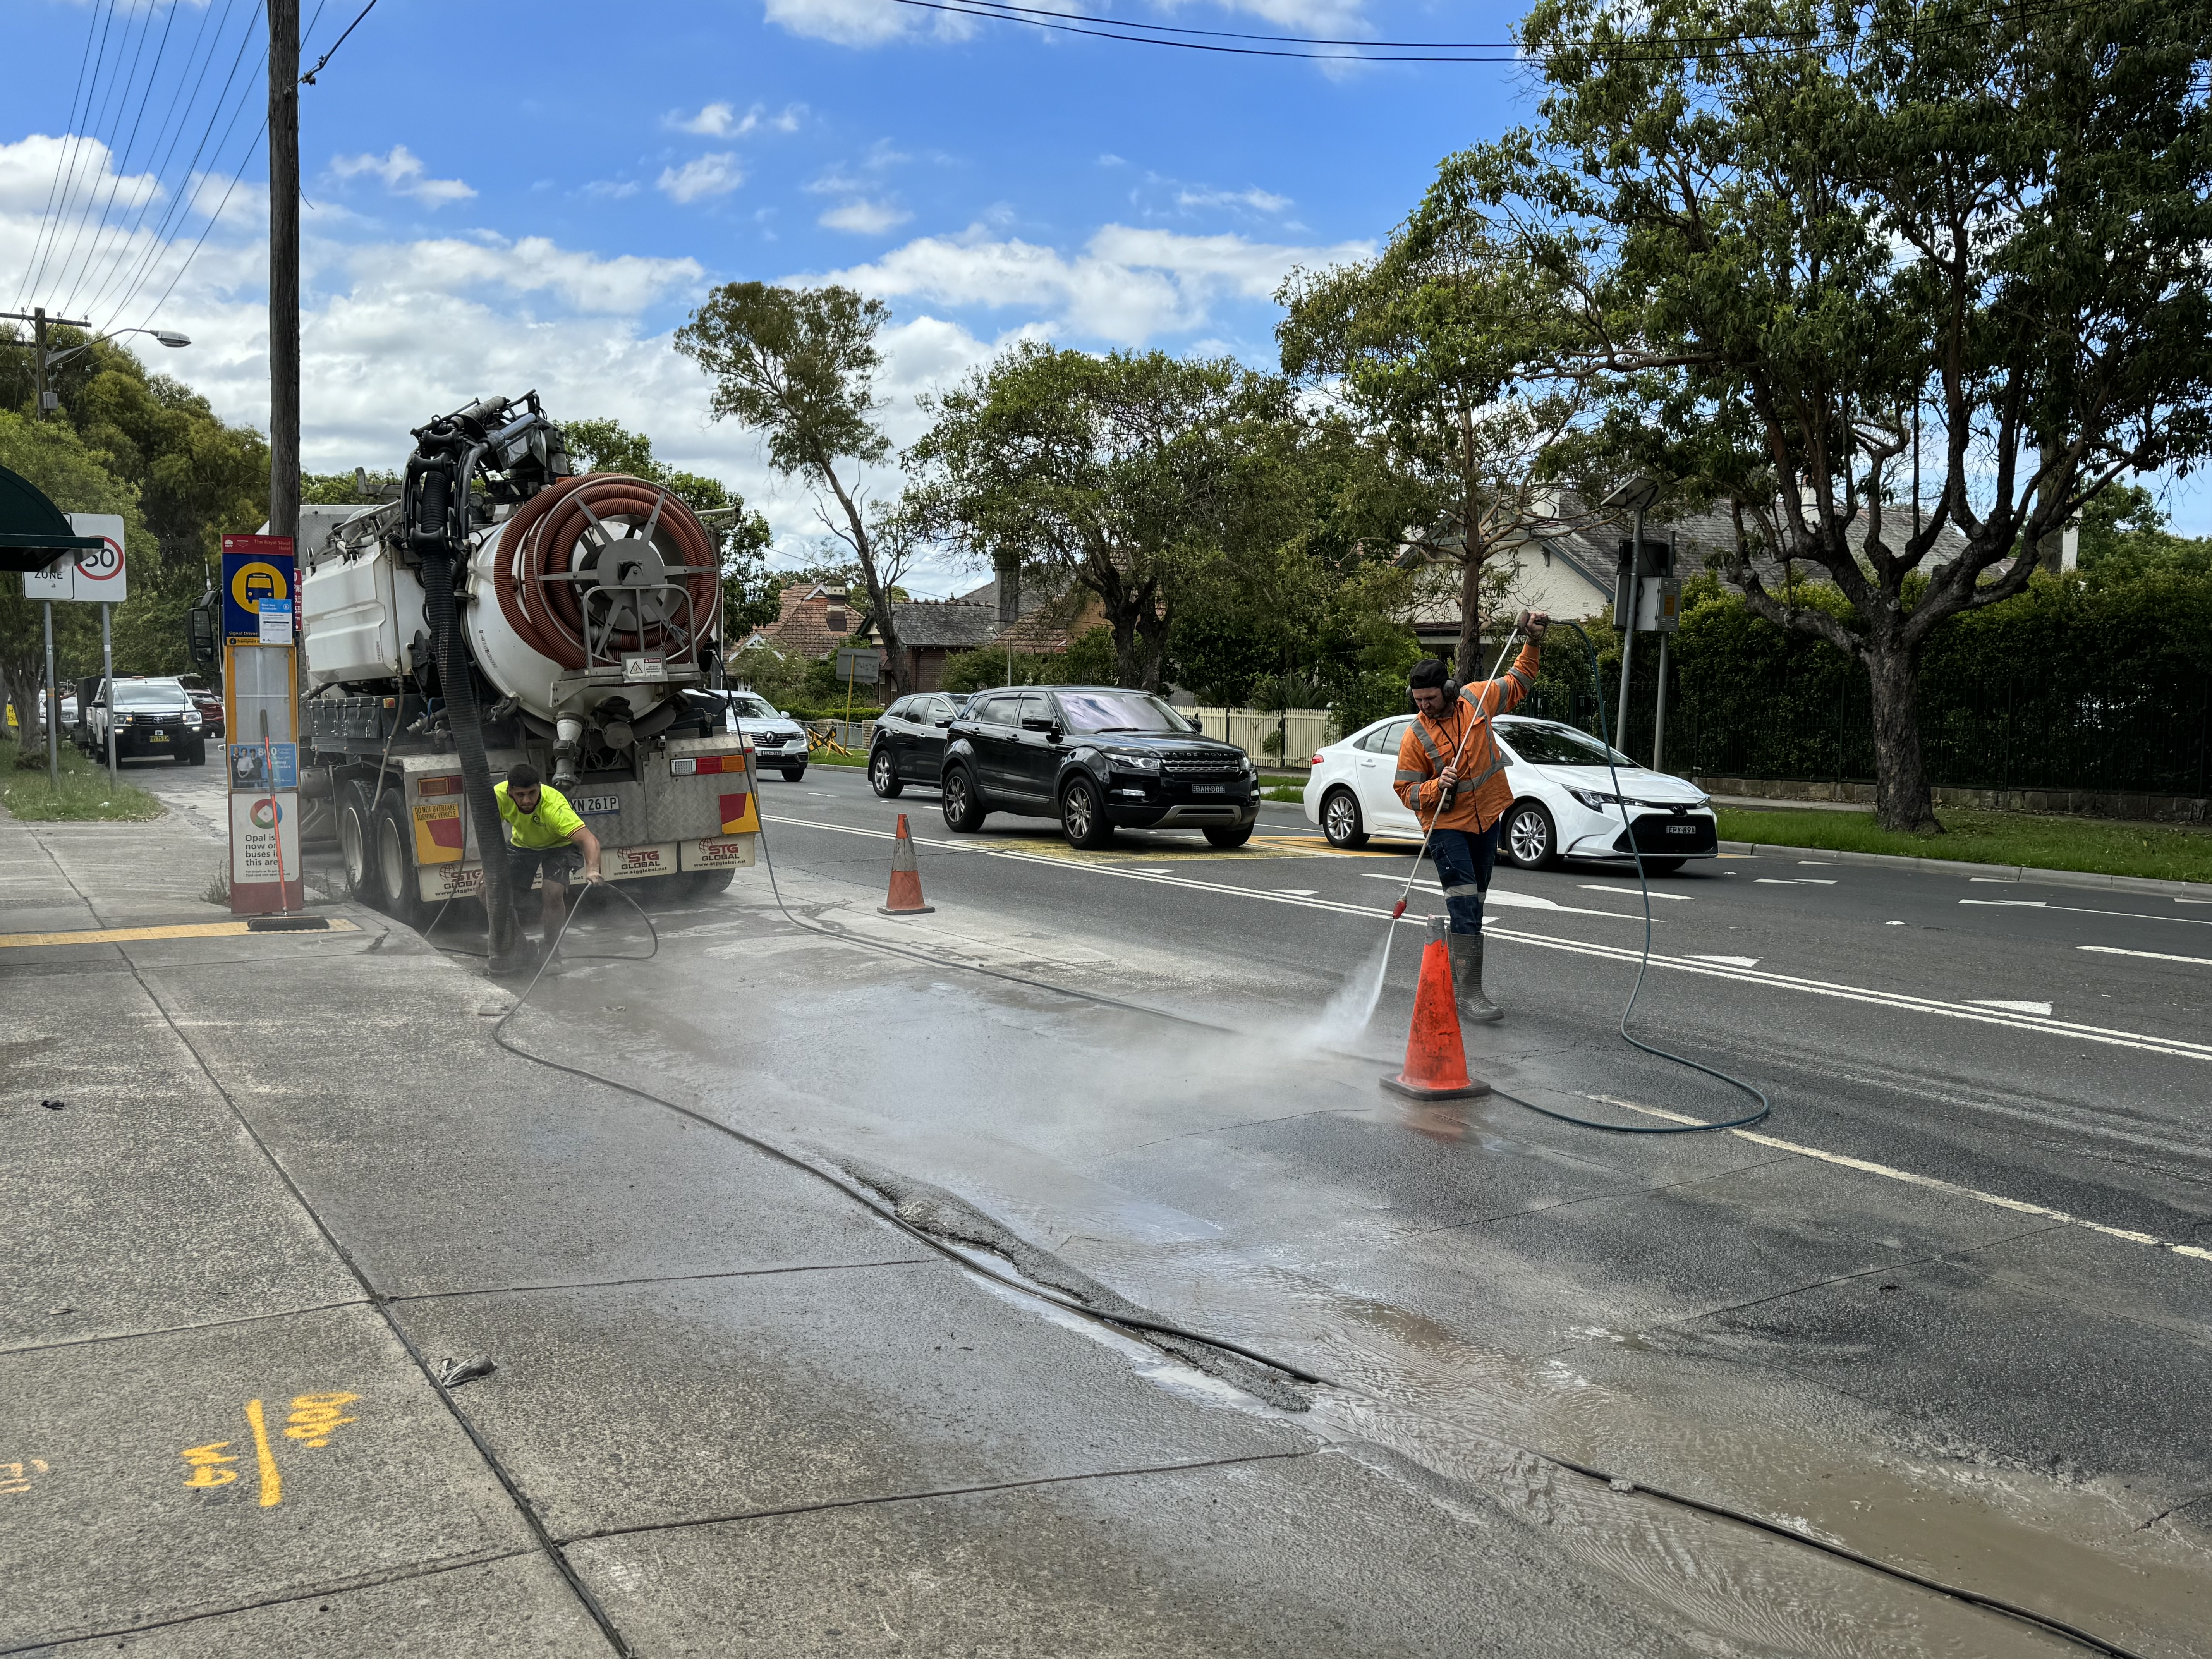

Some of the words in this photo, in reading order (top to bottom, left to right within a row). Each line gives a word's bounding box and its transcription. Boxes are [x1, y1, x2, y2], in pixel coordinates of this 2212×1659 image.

[258, 747, 277, 756] 80
[433, 804, 456, 812] OVERTAKE
[417, 813, 436, 821] TURNING
[245, 834, 266, 843] Opal
[708, 843, 738, 855] STG
[628, 851, 659, 863] STG
[622, 861, 661, 869] GLOBAL
